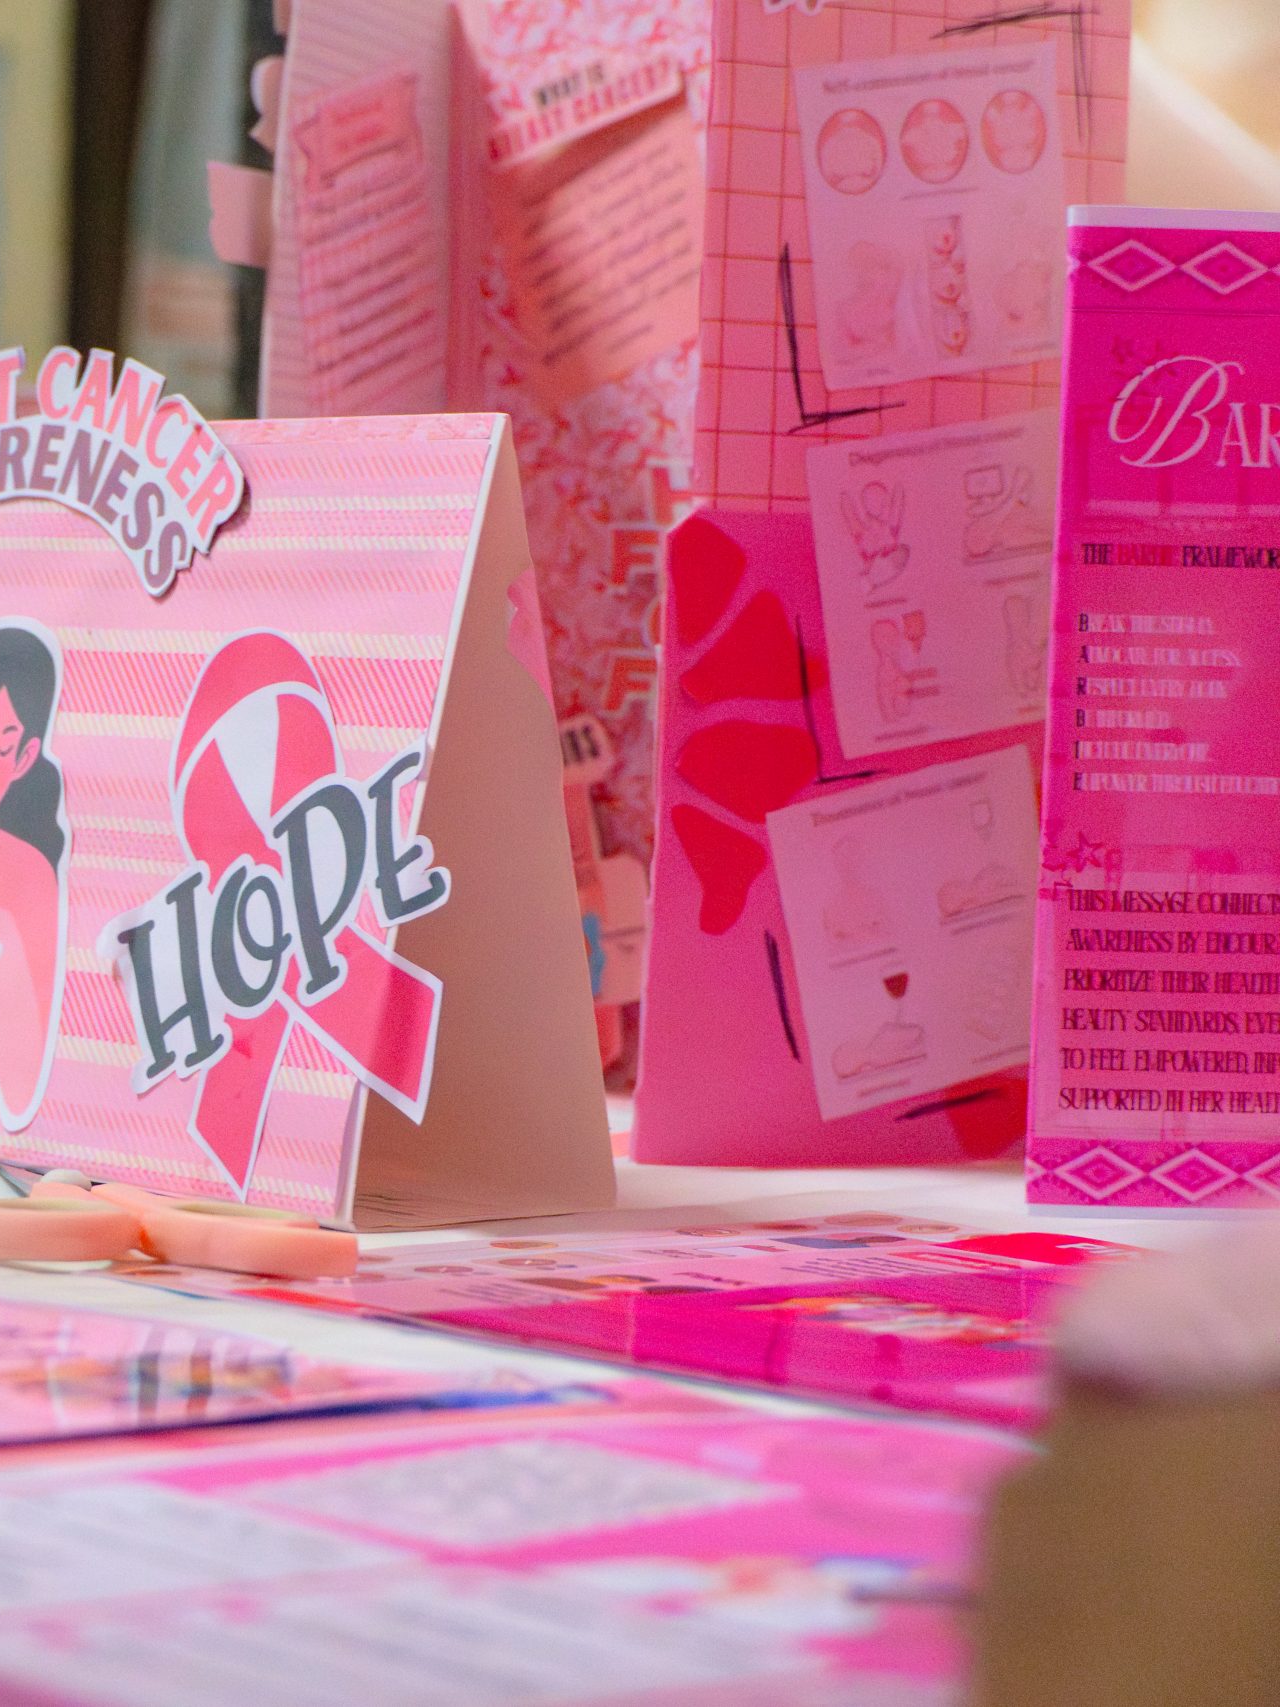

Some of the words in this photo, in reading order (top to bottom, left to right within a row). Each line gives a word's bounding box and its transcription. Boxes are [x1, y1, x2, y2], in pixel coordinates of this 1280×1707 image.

[39, 351, 236, 538] CANCER
[1082, 543, 1112, 566] THE
[117, 750, 448, 1079] HOPE
[1111, 890, 1194, 914] MESSAGE
[1196, 891, 1280, 915] CONNECT
[1065, 928, 1174, 953] AWARENESS
[1177, 931, 1202, 954] BY
[1206, 932, 1280, 956] ENCOUR
[1063, 968, 1155, 992] PRIORITIZE
[1160, 970, 1211, 994] THEIR
[1062, 1007, 1130, 1031] BEAUTY
[1061, 1047, 1086, 1071] TO
[1088, 1048, 1128, 1072] FEEL
[1253, 1051, 1280, 1075] INF
[1058, 1087, 1163, 1112] SUPPORTED
[1165, 1089, 1186, 1112] IN
[1188, 1089, 1225, 1114] HER
